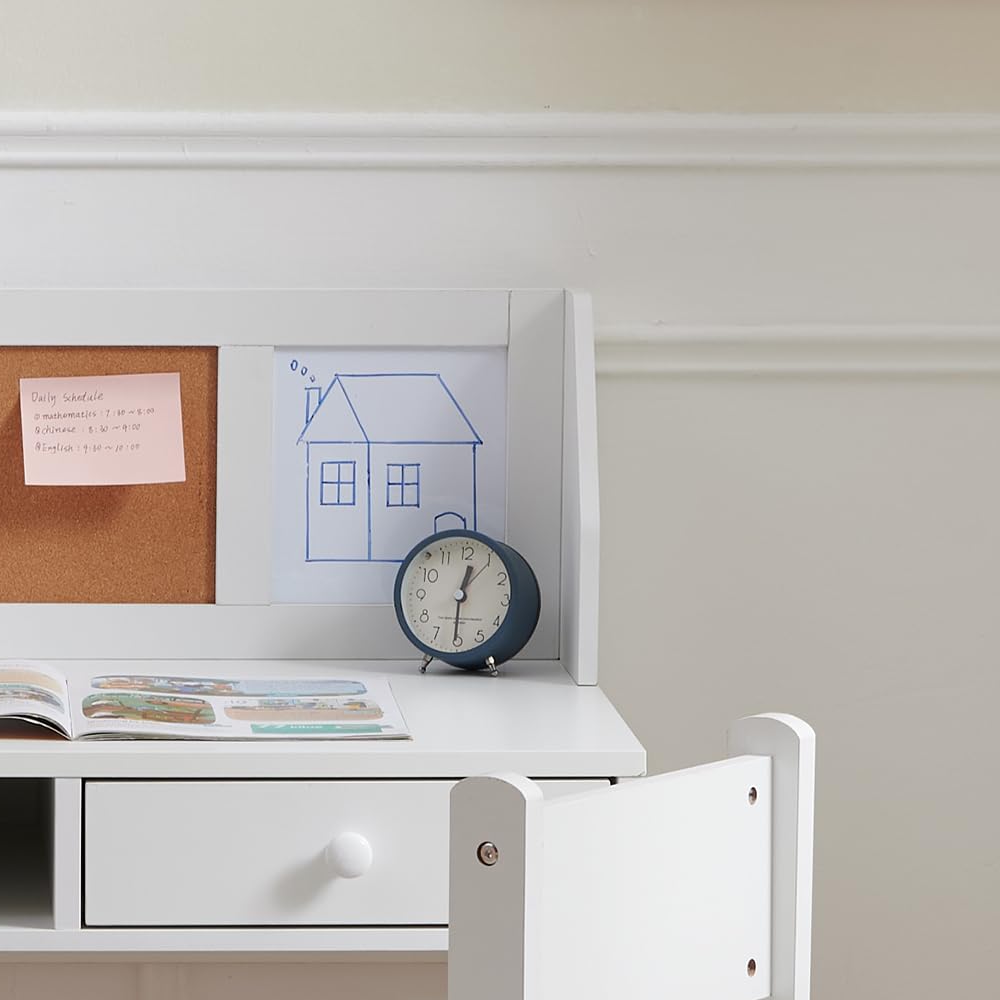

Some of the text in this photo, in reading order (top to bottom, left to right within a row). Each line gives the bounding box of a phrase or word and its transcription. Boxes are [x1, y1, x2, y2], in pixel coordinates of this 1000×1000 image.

[441, 551, 451, 565] 11
[461, 547, 475, 561] 12
[423, 568, 439, 583] 10
[497, 572, 508, 586] 2
[416, 588, 426, 601] 9
[500, 594, 511, 607] 3
[419, 609, 430, 623] 8
[493, 615, 500, 627] 4
[433, 626, 441, 640] 7
[474, 630, 485, 643] 5
